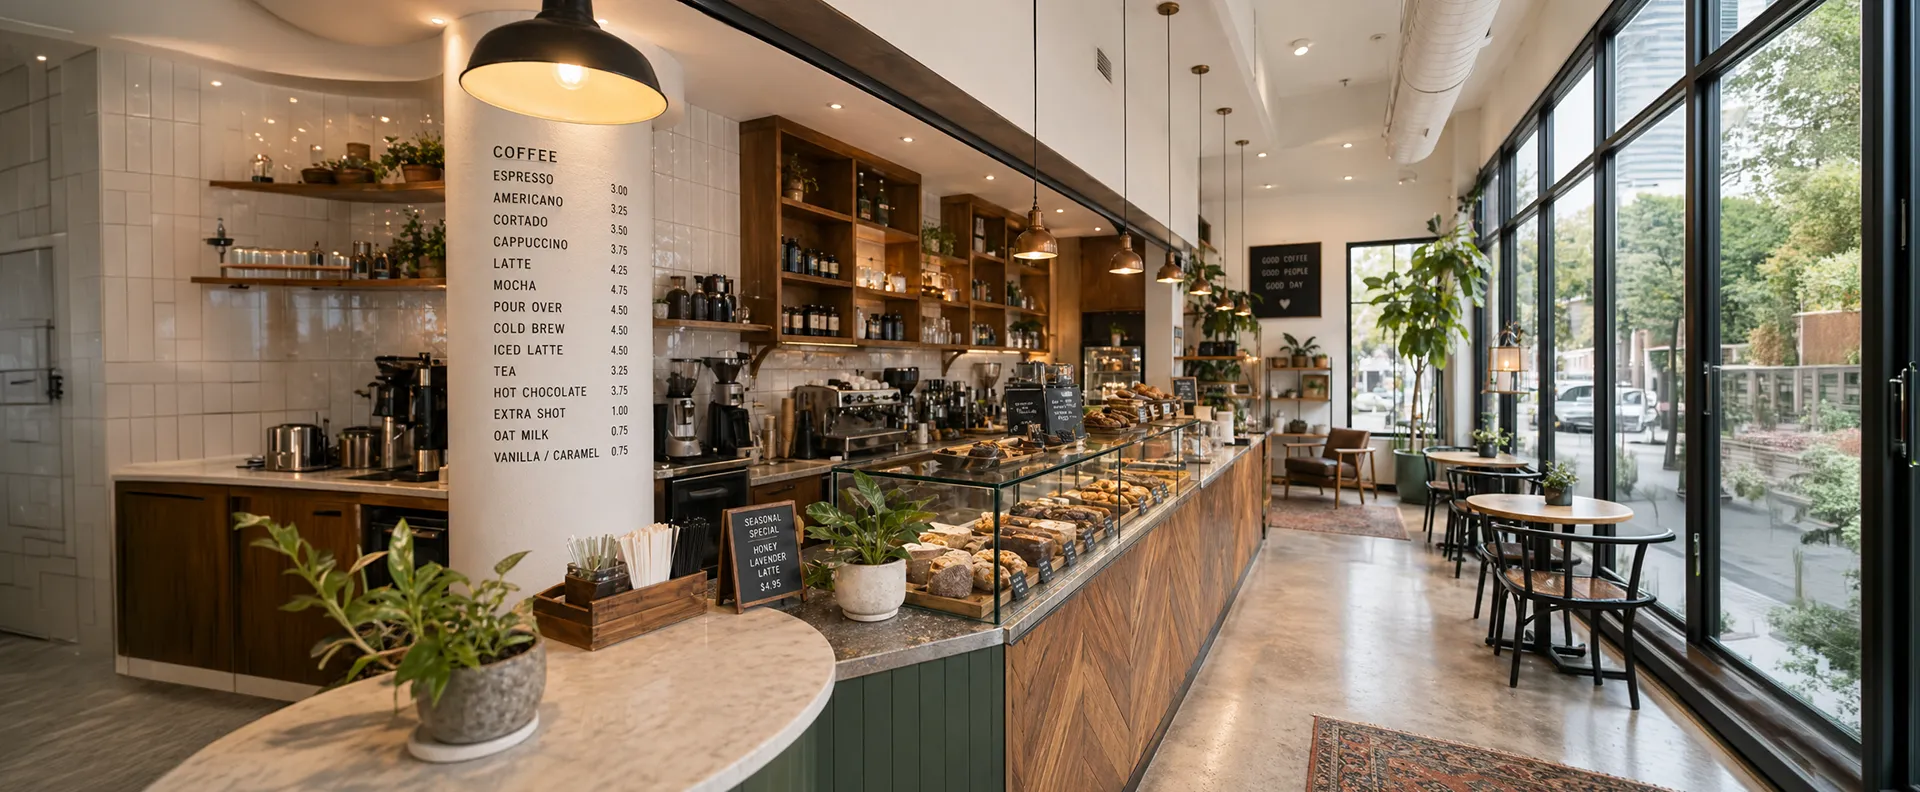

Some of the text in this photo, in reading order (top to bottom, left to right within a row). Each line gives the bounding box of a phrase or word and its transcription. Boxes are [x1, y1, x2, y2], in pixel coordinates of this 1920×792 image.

[493, 145, 558, 163] COFFEE
[493, 170, 629, 196] ESPRESSO 3.00
[493, 192, 629, 216] AMERICANO 3.25
[493, 214, 629, 236] CORTADO 3.50
[493, 236, 629, 256] CAPPUCCINO 3.75
[1261, 254, 1308, 265] GOOD COFFEE
[493, 258, 629, 276] LATTE 4.25
[1261, 267, 1309, 277] GOOD PEOPLE
[493, 279, 629, 296] MOCHA 4.75
[1265, 280, 1304, 290] GOOD DAY
[493, 301, 629, 316] POUR OVER 4.50
[493, 323, 629, 336] COLD BREW 4.50
[493, 344, 629, 356] ICED LATTE 4.50
[493, 365, 629, 377] TEA 3.25
[493, 385, 629, 398] HOT CHOCOLATE 3.75
[493, 405, 629, 420] EXTRA SHOT 1.00
[493, 425, 629, 441] OAT MILK 0.75
[493, 450, 541, 463] VANILLA
[553, 447, 600, 461] CARAMEL
[610, 445, 629, 456] 0.75
[744, 513, 782, 527] SEASONAL
[749, 525, 780, 538] SPECIAL
[753, 541, 778, 555] HONEY
[749, 552, 787, 568] LAVENDER
[757, 565, 781, 578] LATTE
[760, 578, 782, 592] $4.95
